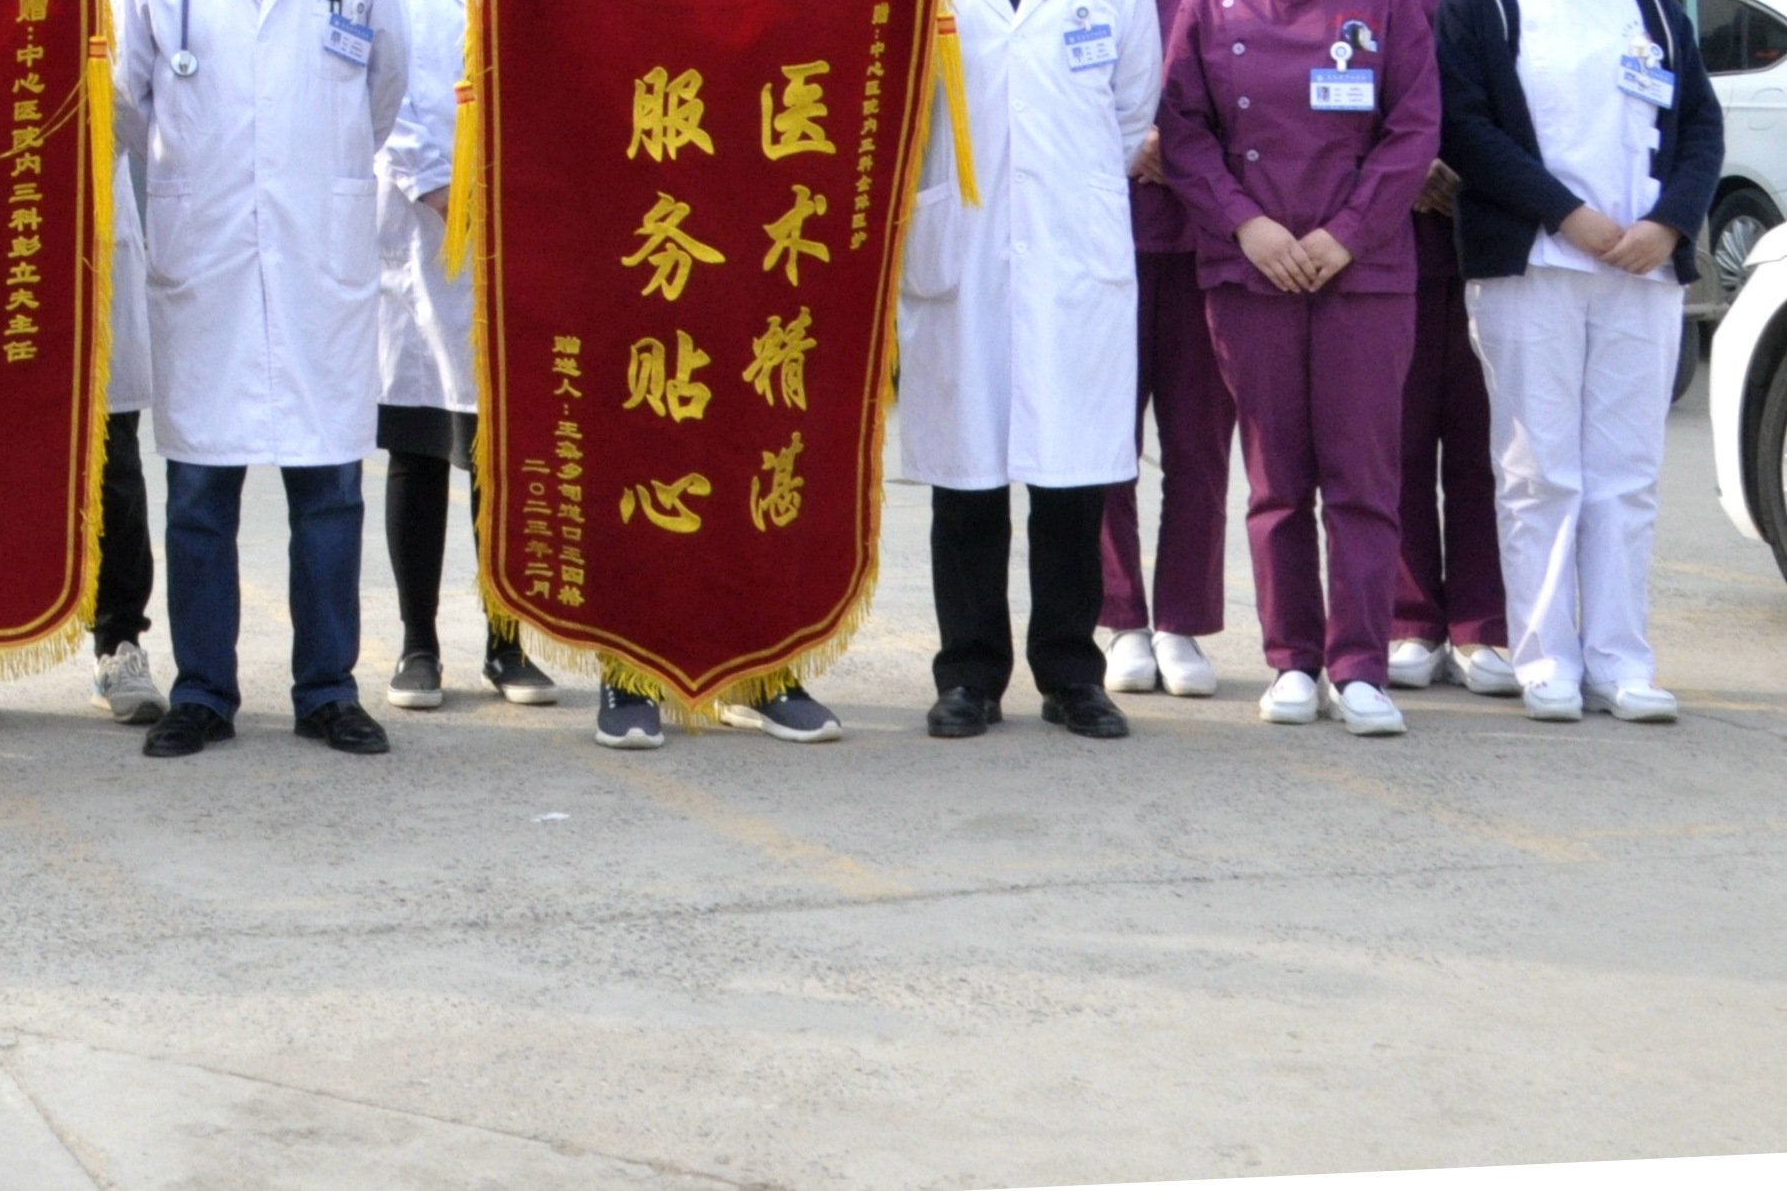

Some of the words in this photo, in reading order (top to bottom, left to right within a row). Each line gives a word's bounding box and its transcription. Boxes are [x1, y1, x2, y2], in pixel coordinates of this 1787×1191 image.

[620, 66, 726, 533] 服务贴心
[742, 60, 836, 532] 医术精湛
